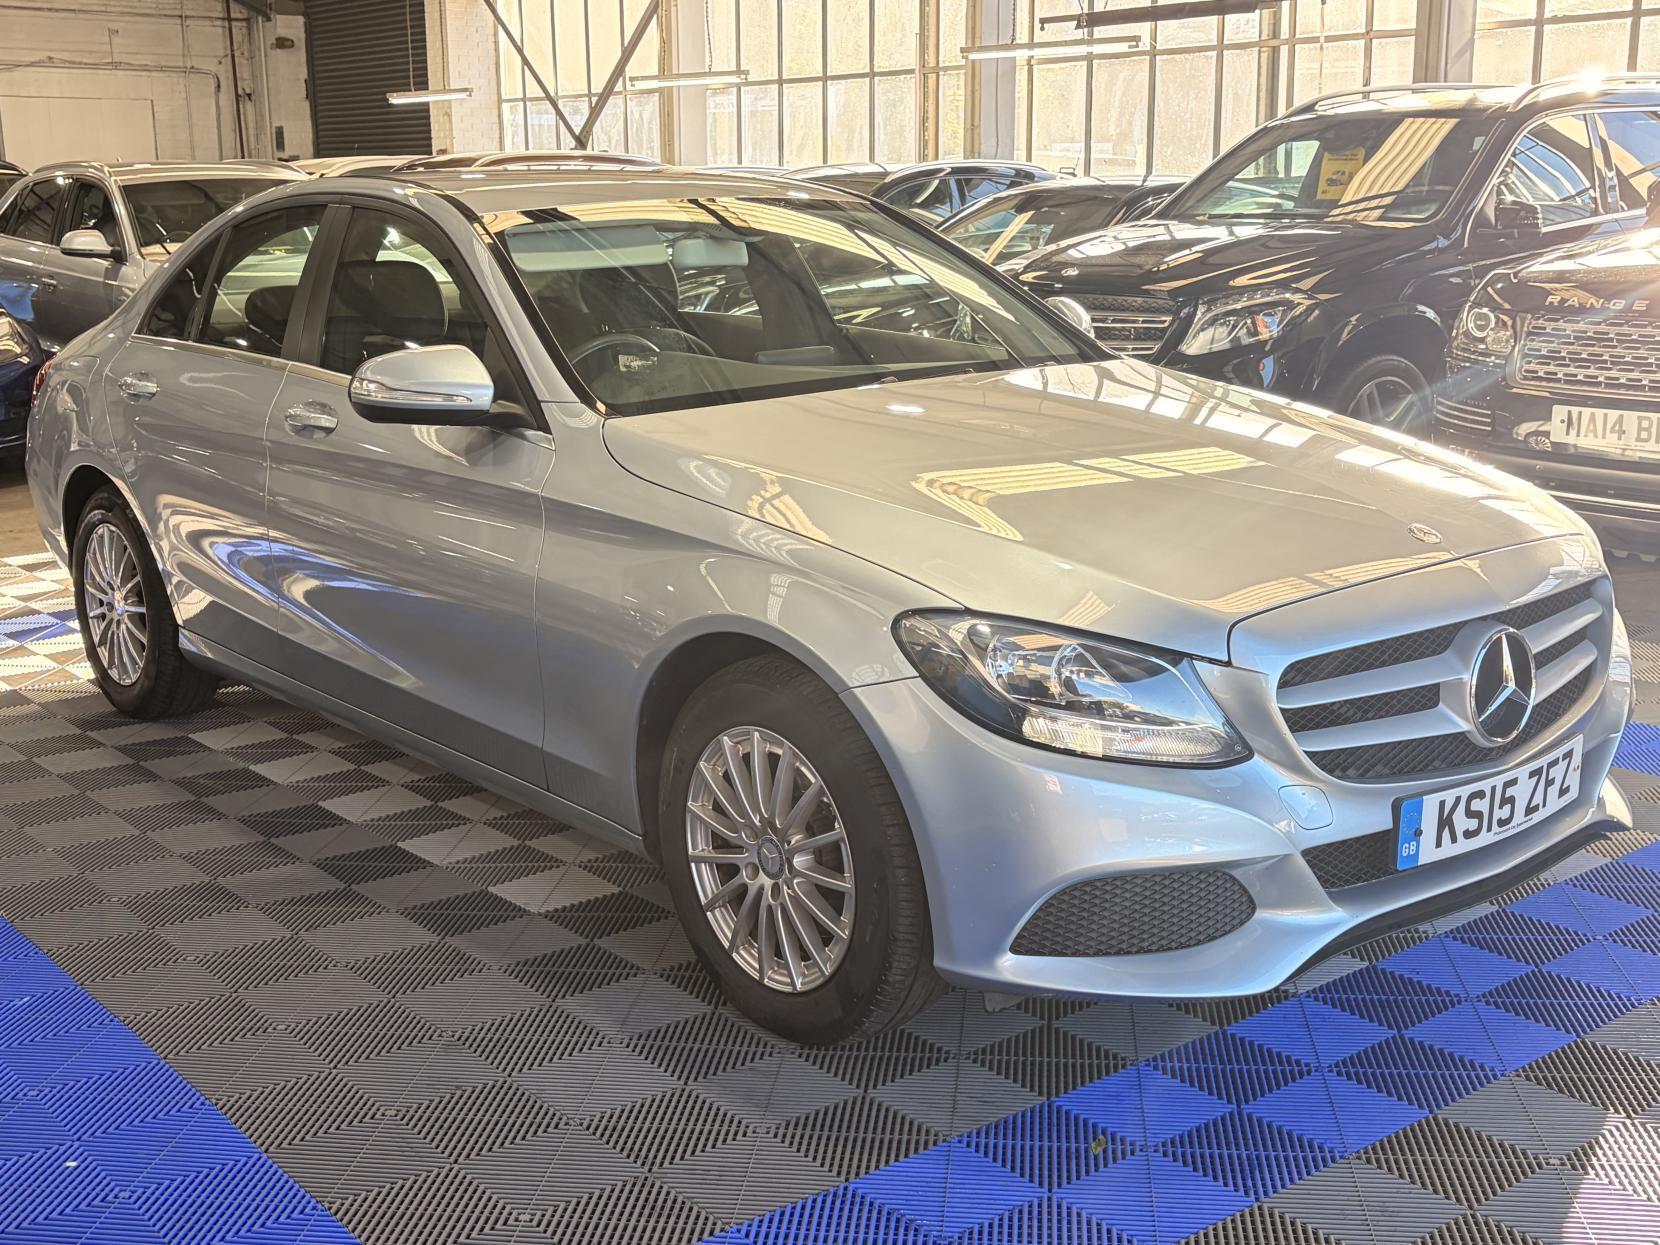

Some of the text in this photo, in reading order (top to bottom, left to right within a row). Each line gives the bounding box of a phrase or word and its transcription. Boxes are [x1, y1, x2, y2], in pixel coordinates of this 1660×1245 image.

[1544, 295, 1650, 311] RANGE
[1565, 409, 1626, 441] NA14
[1434, 747, 1575, 849] KS15 ZFZ
[1402, 841, 1417, 857] GB
